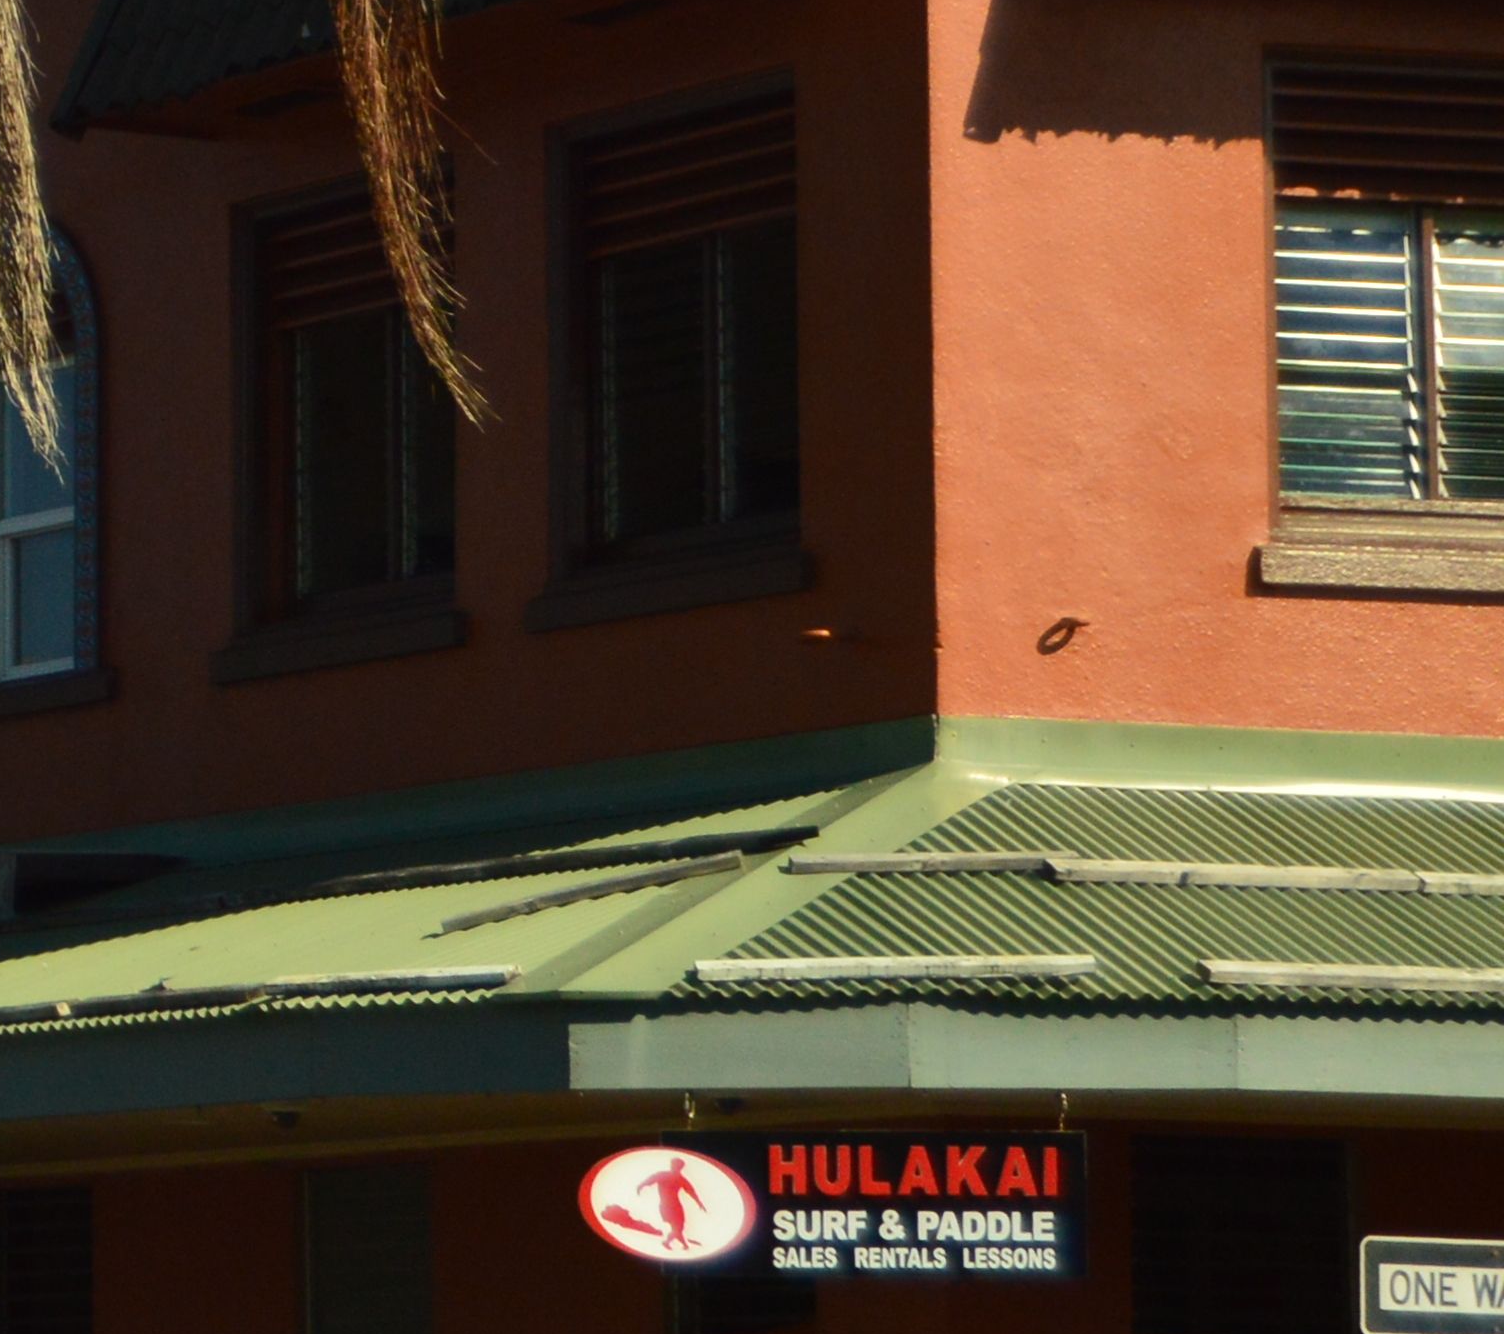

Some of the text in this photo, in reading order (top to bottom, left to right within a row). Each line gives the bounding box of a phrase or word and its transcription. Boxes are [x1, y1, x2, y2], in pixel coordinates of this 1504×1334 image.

[768, 1144, 1059, 1197] HULAKAI
[773, 1210, 1056, 1242] SURF & PADDLE
[772, 1247, 1057, 1270] SALES RENTALS LESSONS
[1390, 1270, 1458, 1307] ONE
